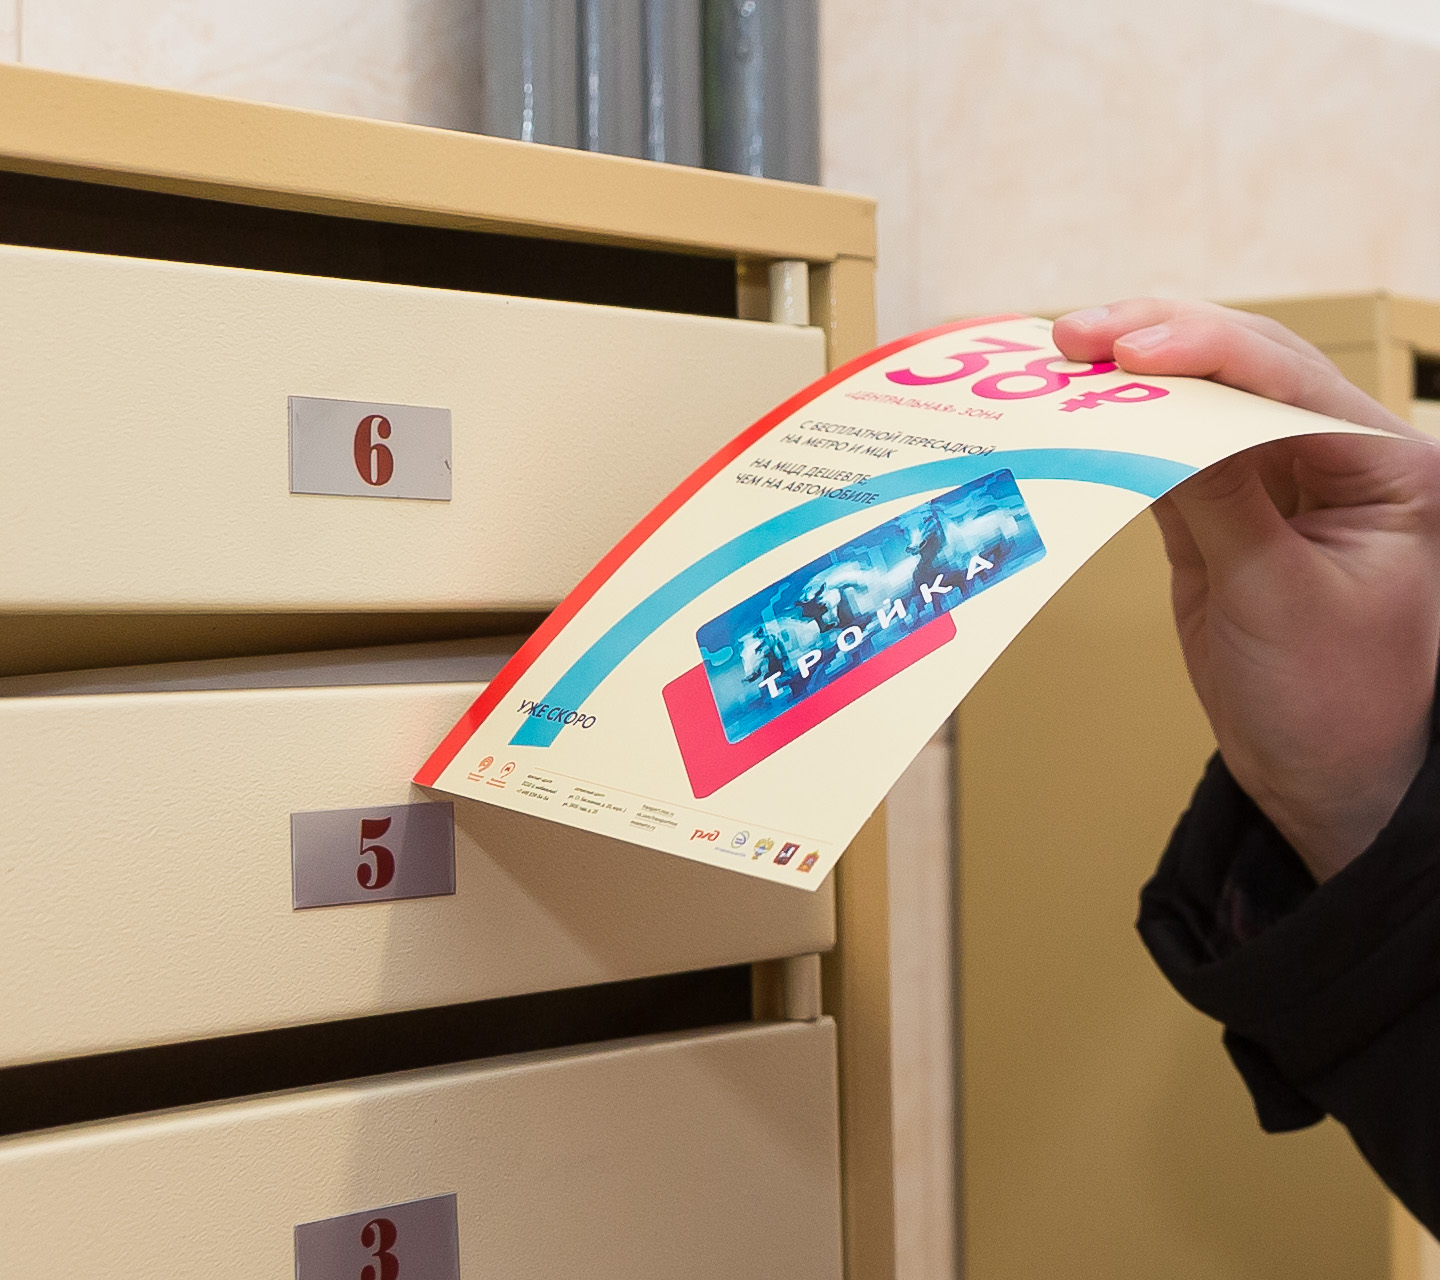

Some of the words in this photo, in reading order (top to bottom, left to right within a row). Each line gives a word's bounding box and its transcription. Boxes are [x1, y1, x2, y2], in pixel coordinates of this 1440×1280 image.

[957, 407, 1004, 421] ЗОНА
[353, 414, 394, 487] 6
[780, 433, 807, 445] НА
[805, 437, 850, 452] МЕТРО
[846, 442, 864, 454] И
[863, 445, 900, 460] МЦК
[800, 420, 812, 430] С
[809, 420, 904, 444] БЕСПЛАТНОЙ
[899, 433, 998, 457] ПЕРЕСАДКОЙ
[750, 457, 776, 469] НА
[774, 460, 807, 477] МЦД
[735, 473, 763, 485] ЧЕМ
[763, 478, 788, 490] НА
[784, 481, 880, 505] АВТОМОБИЛЕ
[758, 554, 995, 699] ТРОЙКА
[517, 699, 550, 718] УЖЕ
[546, 706, 597, 729] СКОРО
[356, 816, 396, 890] 5
